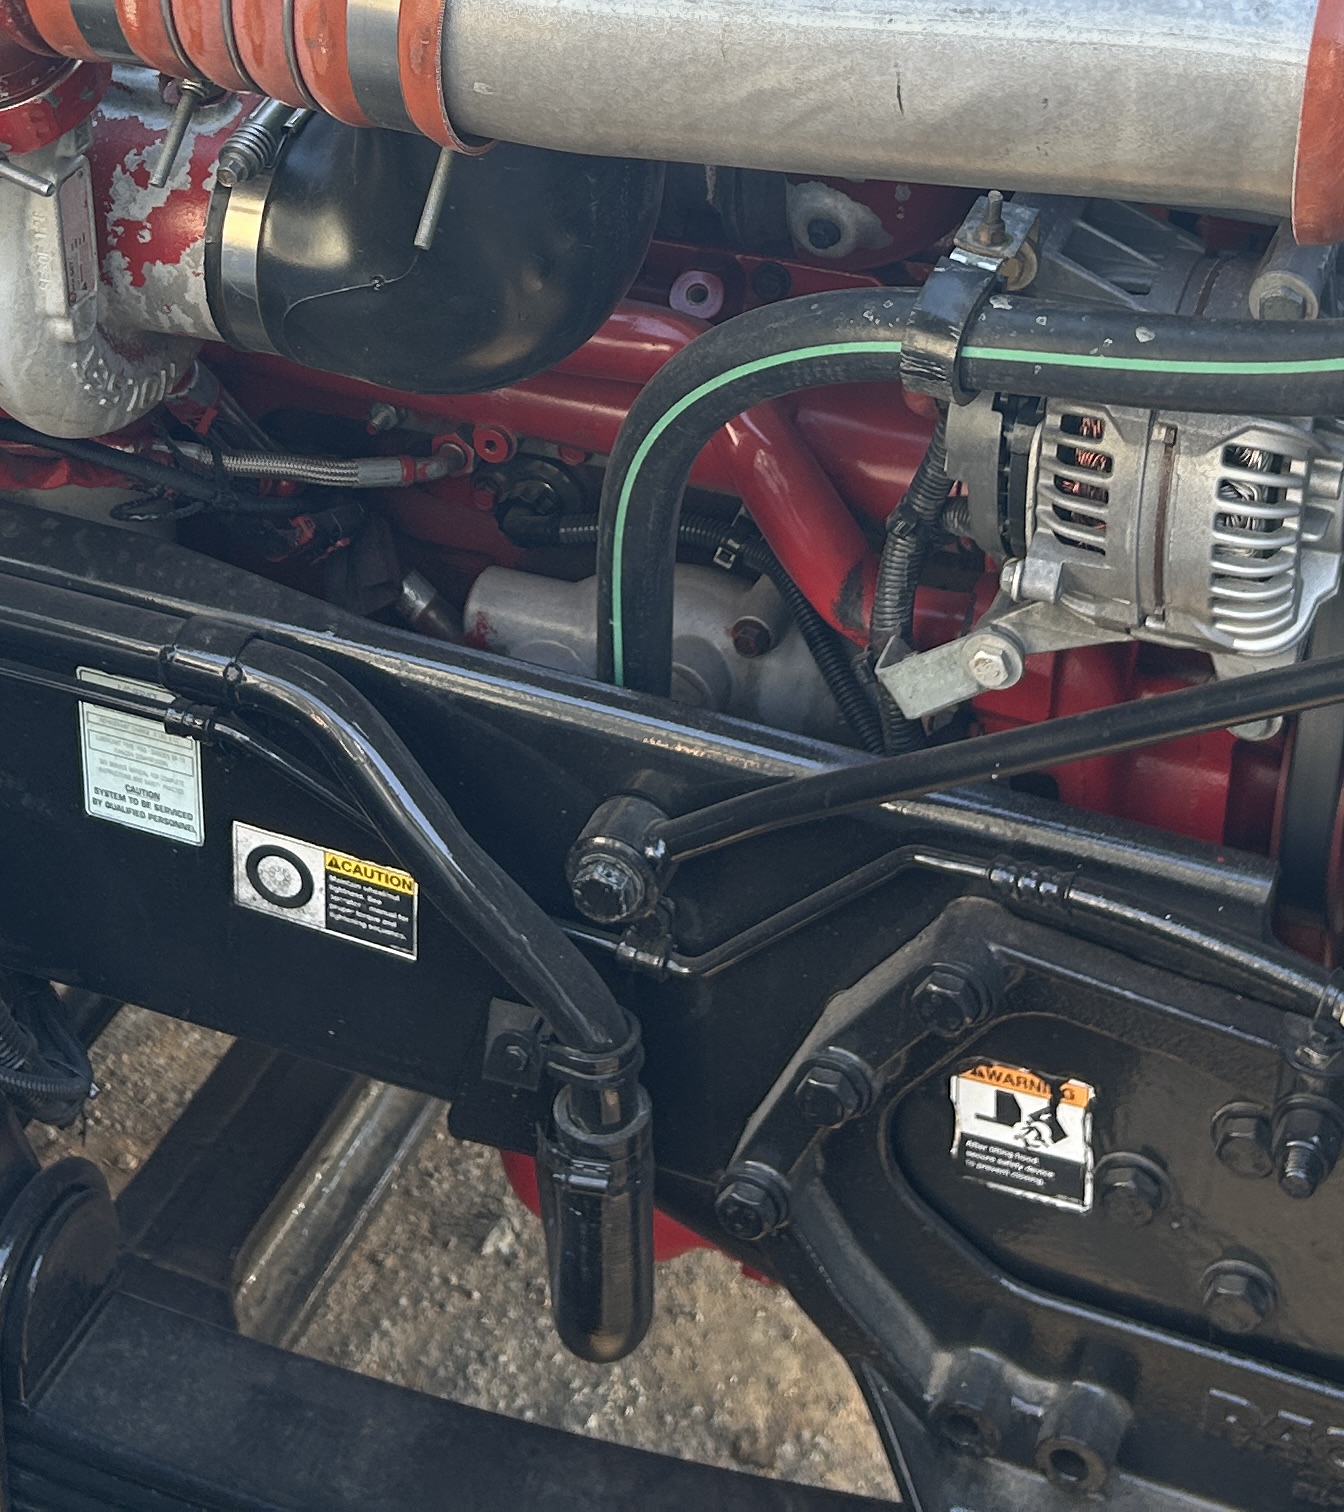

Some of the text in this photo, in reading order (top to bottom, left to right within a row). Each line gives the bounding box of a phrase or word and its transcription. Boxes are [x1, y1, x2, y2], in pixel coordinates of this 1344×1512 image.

[94, 786, 194, 821] SYSTEM TO BE SERVICED
[125, 783, 161, 801] CAUTION
[92, 797, 197, 834] BY QUALIFIED PERSONNEL
[341, 860, 412, 891] CAUTION
